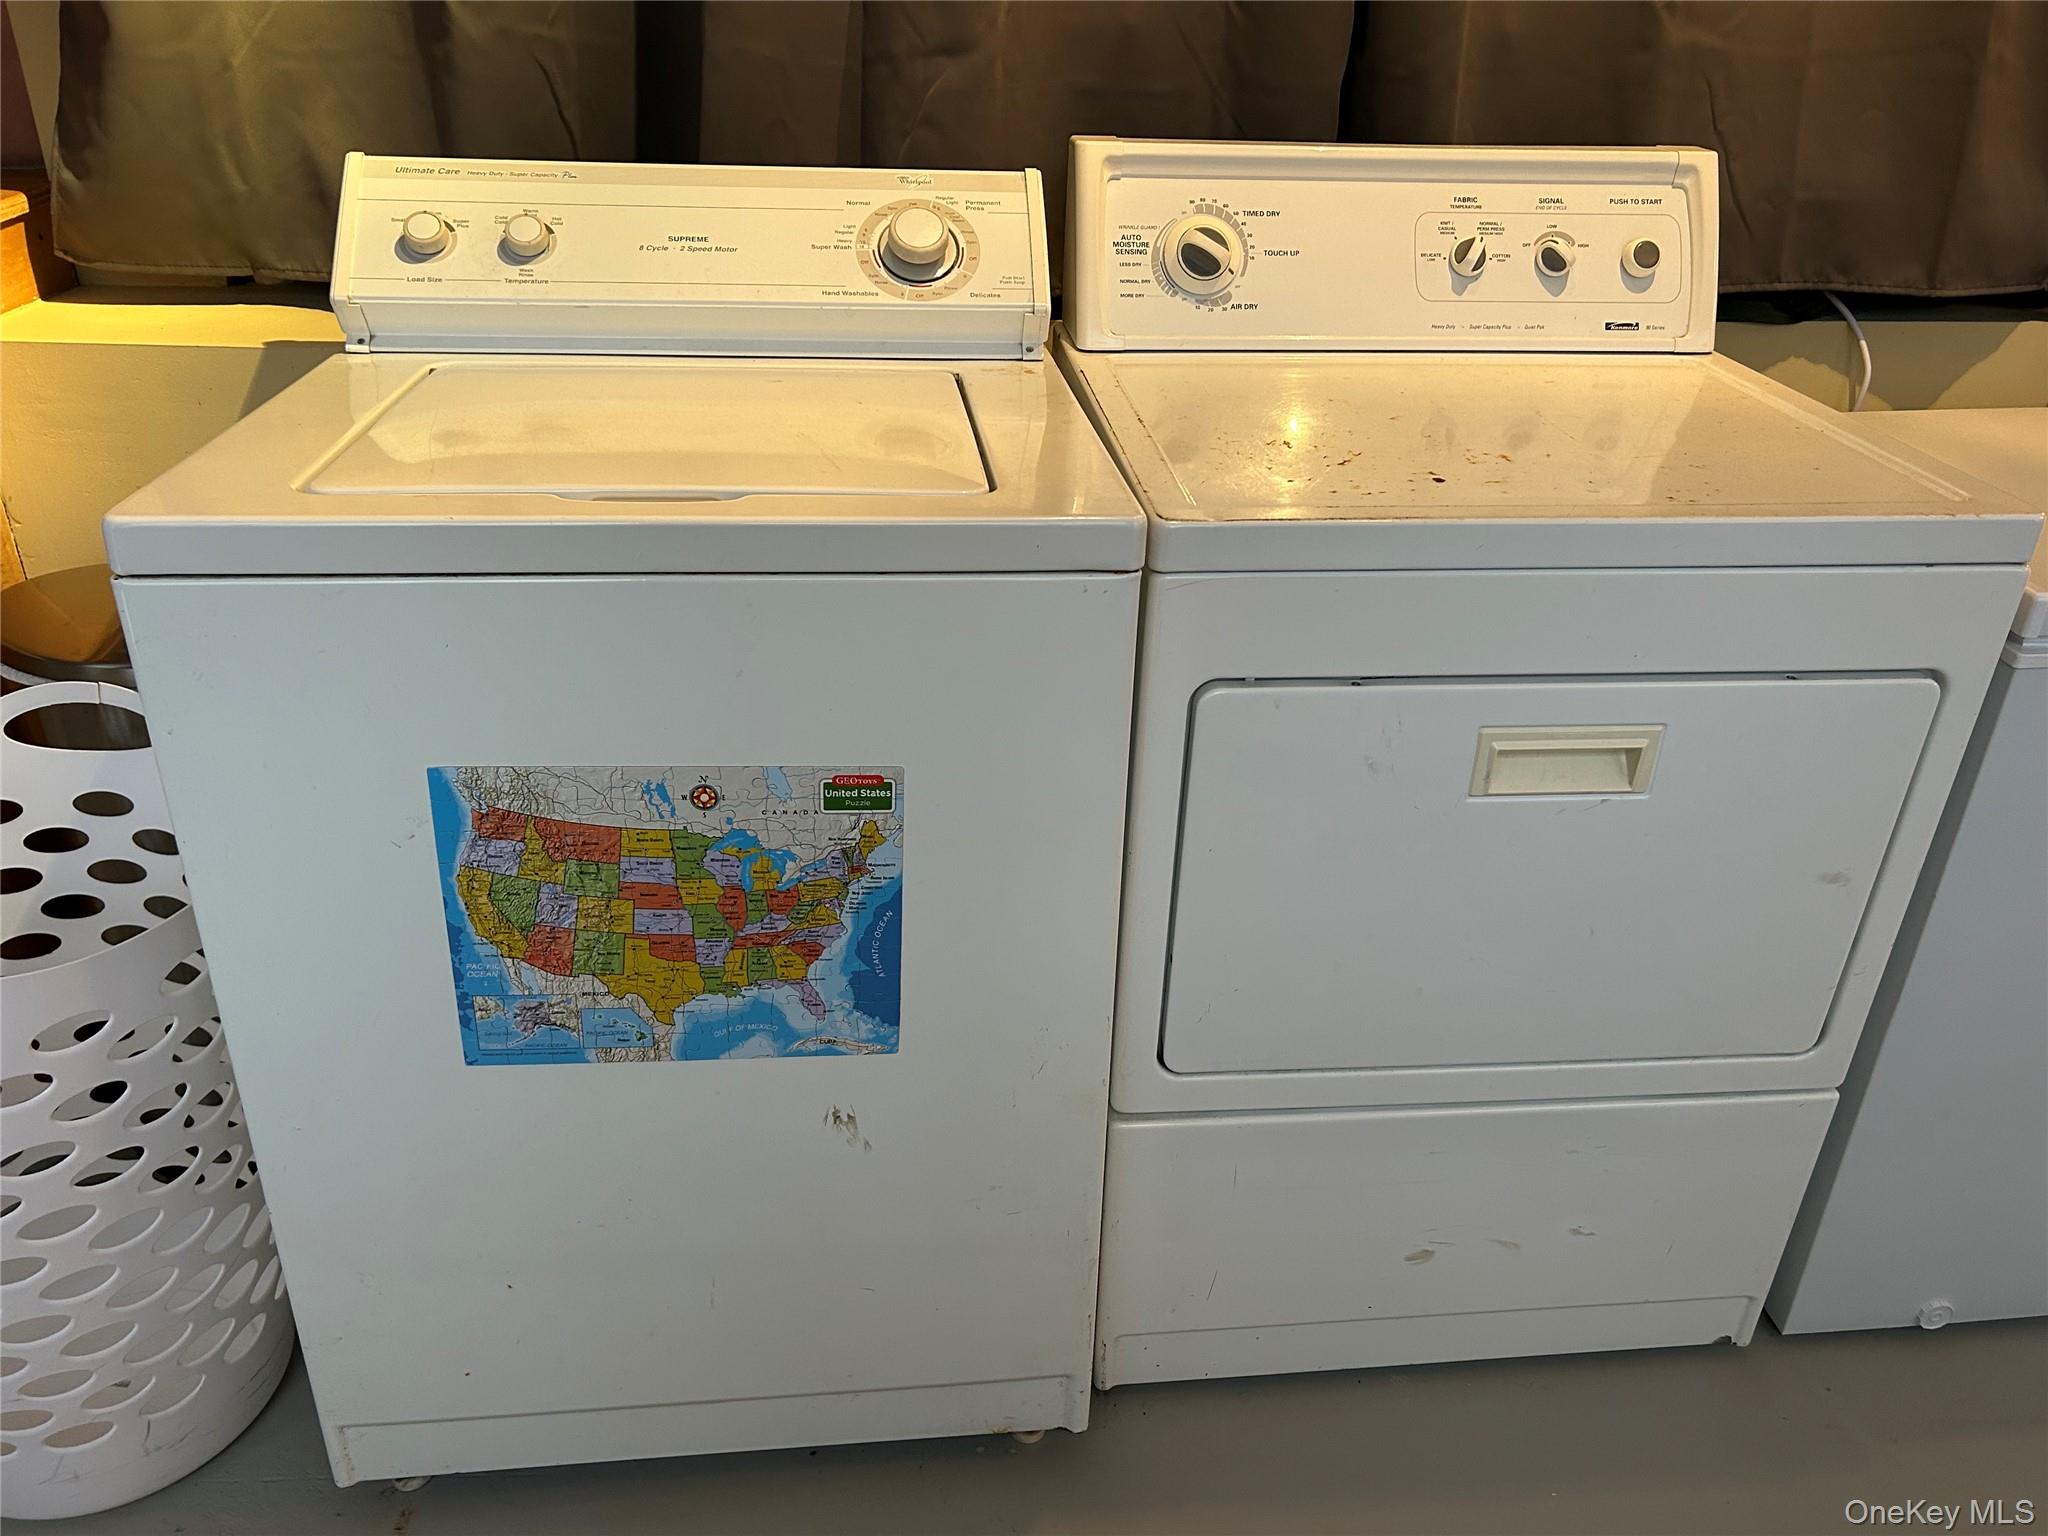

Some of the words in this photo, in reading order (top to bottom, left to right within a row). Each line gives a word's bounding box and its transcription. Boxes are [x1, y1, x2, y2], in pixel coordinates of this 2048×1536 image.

[395, 166, 435, 176] Ultimate
[438, 168, 461, 177] Care
[467, 169, 486, 177] Heavy
[489, 170, 504, 178] Duty
[509, 171, 528, 179] Super
[530, 171, 559, 179] Capacity
[897, 175, 932, 187] Whirlpool
[1453, 196, 1478, 204] FABRIC
[1538, 197, 1564, 205] SIGNAL
[1641, 198, 1662, 206] START
[667, 235, 710, 243] SUPREME
[646, 245, 669, 253] Cycle
[811, 244, 832, 252] Super
[1115, 248, 1148, 256] SENSING
[1263, 249, 1288, 257] TOUCH
[1290, 249, 1300, 257] UP
[825, 788, 857, 798] United
[860, 788, 891, 798] States
[846, 798, 871, 807] Puzzle
[761, 808, 820, 816] CANADA
[874, 910, 894, 938] OCEAN
[467, 972, 499, 981] OCEAN
